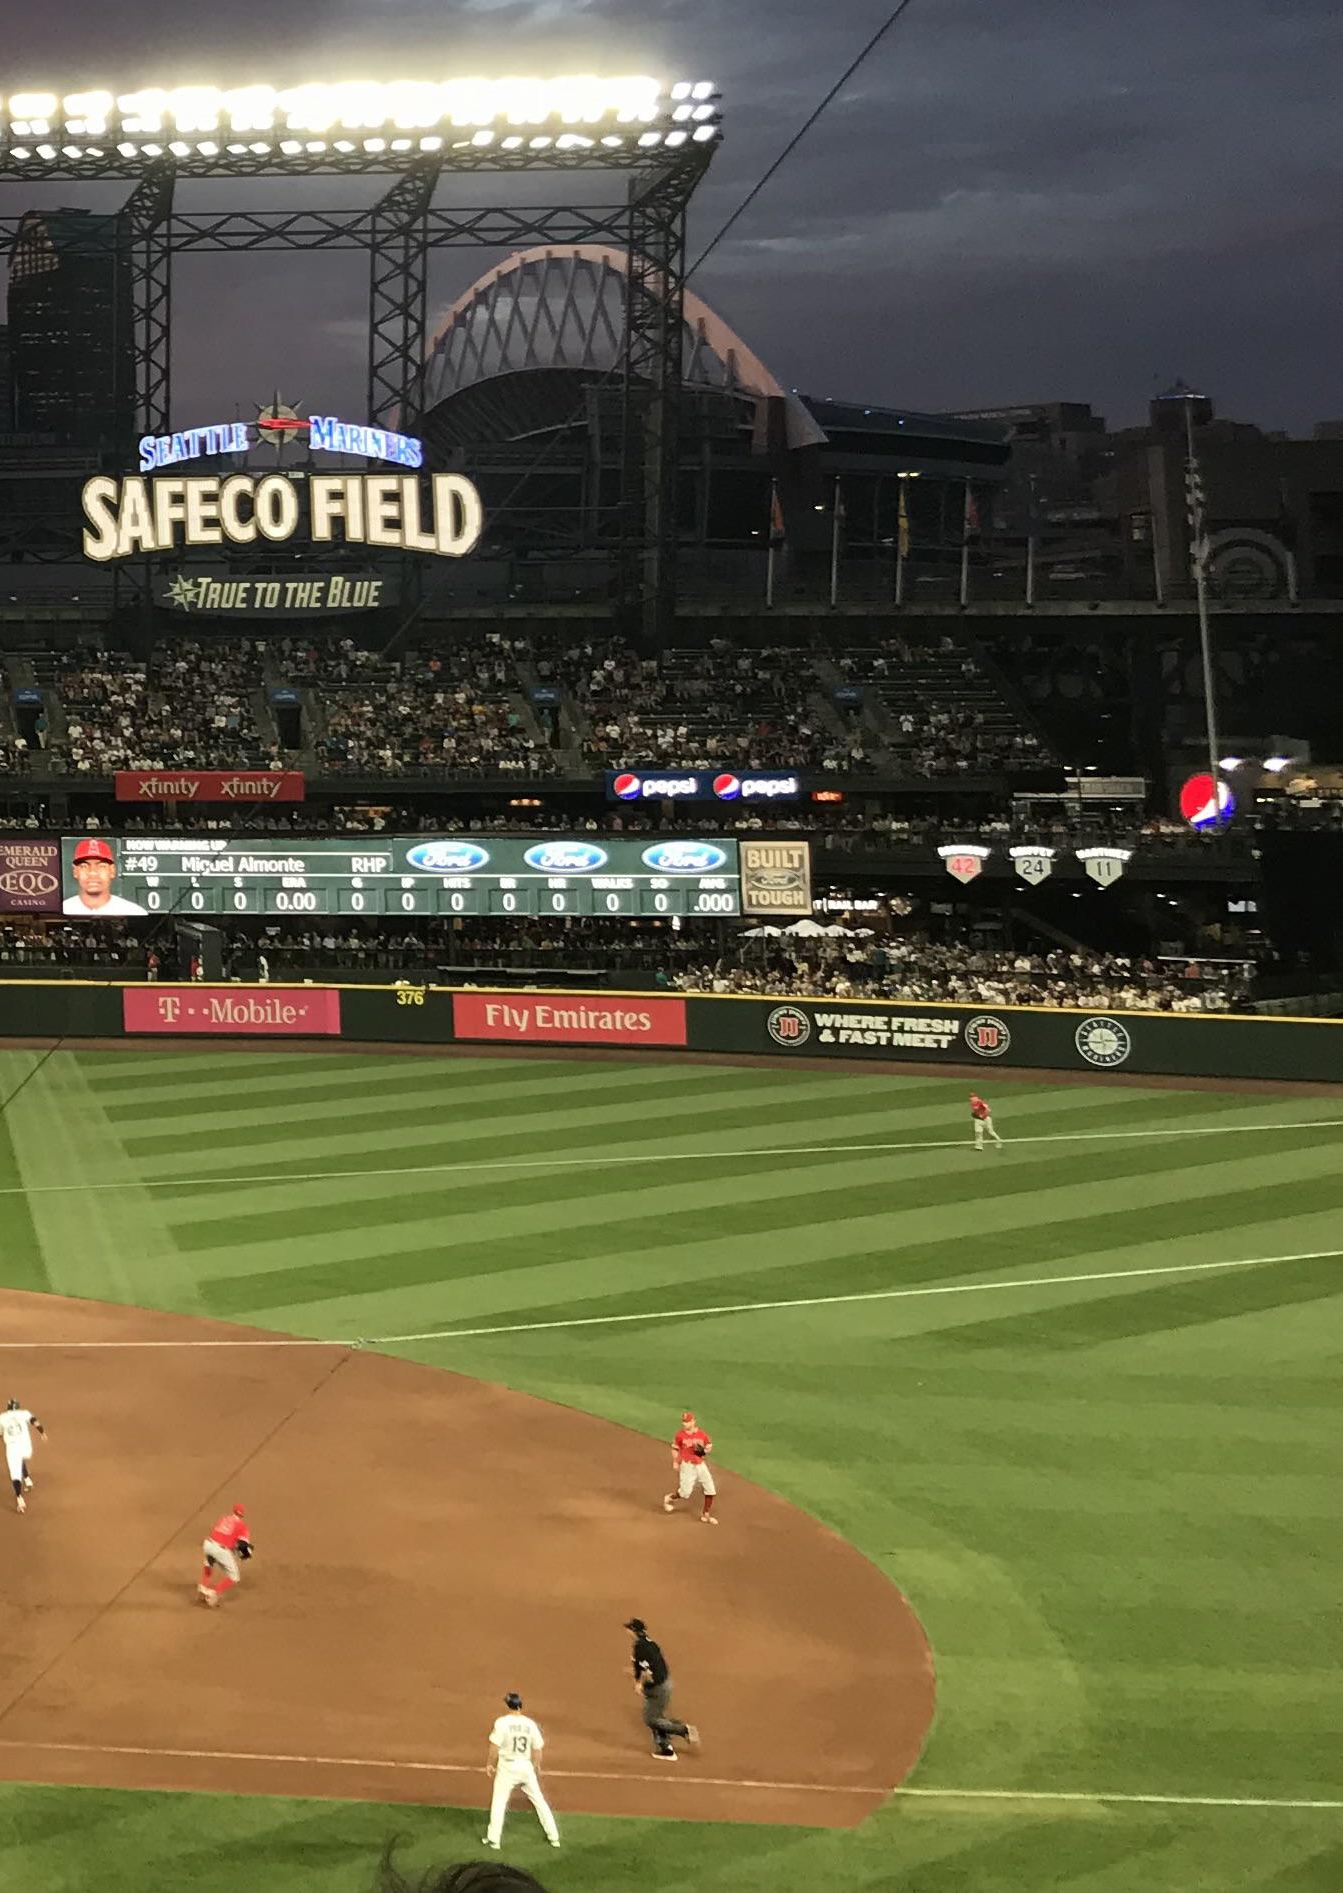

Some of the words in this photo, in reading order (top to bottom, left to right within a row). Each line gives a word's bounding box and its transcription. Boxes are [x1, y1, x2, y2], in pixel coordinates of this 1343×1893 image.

[139, 422, 250, 471] SEATTLE
[309, 415, 424, 468] MARINERS
[82, 473, 300, 562] SAFECO
[310, 472, 483, 558] FIELD
[196, 577, 251, 608] TRUE
[254, 582, 282, 608] TO
[284, 581, 325, 608] THE
[326, 576, 383, 608] BLUE
[139, 778, 200, 798] xfinity
[221, 778, 282, 798] xfinity
[642, 778, 698, 797] pepsi
[741, 778, 798, 797] pepsi
[126, 840, 154, 850] NOW
[154, 840, 210, 850] WARMING
[210, 840, 227, 850] UP
[6, 857, 48, 869] QUEEN
[125, 856, 158, 872] #49
[181, 856, 234, 875] Miguel
[238, 856, 306, 872] Almonte
[351, 857, 387, 873] RHP
[747, 849, 802, 868] BUILT
[951, 859, 974, 874] 42
[1023, 860, 1044, 875] 24
[1097, 861, 1111, 876] 11
[6, 873, 54, 896] EQC
[234, 876, 244, 888] S
[281, 877, 307, 888] ERA
[148, 892, 160, 909] 0
[191, 892, 204, 910] 0
[234, 892, 247, 910] 0
[276, 892, 316, 910] 0.00
[351, 893, 364, 910] 0
[402, 893, 415, 911] 0
[451, 893, 464, 911] 0
[503, 893, 516, 911] 0
[552, 893, 565, 911] 0
[606, 894, 619, 911] 0
[654, 894, 667, 911] 0
[694, 894, 734, 912] .000
[748, 890, 804, 905] TOUGH
[396, 990, 425, 1006] 376
[485, 1004, 530, 1032] Fly
[534, 1005, 652, 1031] Emirates
[814, 1013, 889, 1034] WHERE
[891, 1017, 960, 1035] FRESH
[818, 1029, 836, 1044] &
[838, 1031, 891, 1047] FAST
[893, 1034, 952, 1049] MEET
[512, 1736, 528, 1753] 13
